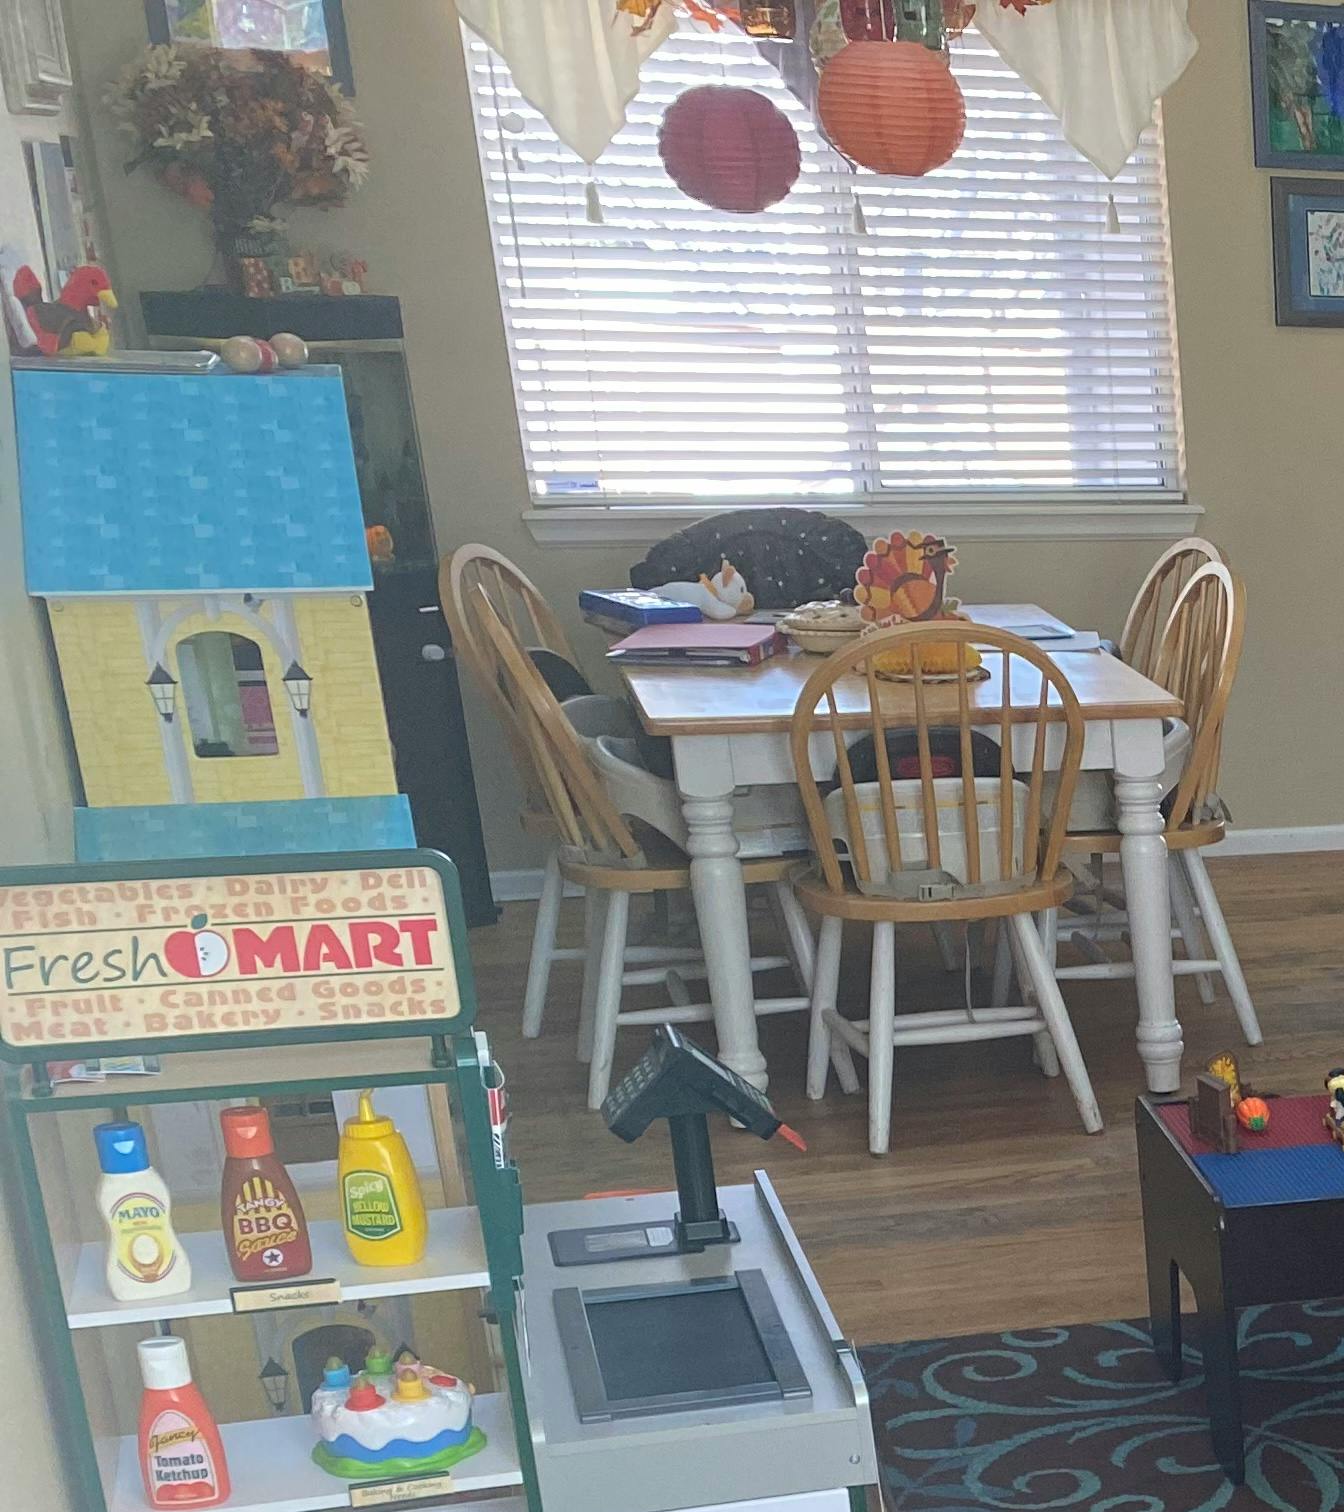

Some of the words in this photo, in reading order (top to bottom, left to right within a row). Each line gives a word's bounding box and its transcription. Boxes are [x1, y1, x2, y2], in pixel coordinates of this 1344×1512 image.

[225, 875, 329, 897] Dairy
[359, 869, 427, 891] Deli
[12, 907, 97, 929] Fish
[136, 900, 274, 923] Frozen
[291, 892, 409, 916] Foods
[4, 935, 168, 990] Fresh
[232, 918, 438, 975] MART
[25, 993, 124, 1017] Fruit
[160, 982, 297, 1009] Canned
[311, 975, 427, 999] Goods
[11, 1017, 109, 1042] Meat
[143, 1008, 281, 1033] Bakery
[318, 997, 447, 1021] Snacks
[350, 1179, 384, 1199] Spicy
[118, 1206, 160, 1223] MAYO
[236, 1198, 284, 1213] TANGY
[238, 1213, 294, 1235] BBQ
[351, 1214, 396, 1226] MUSTARD
[237, 1229, 298, 1260] Sauce
[153, 1453, 204, 1467] Tomato
[155, 1468, 209, 1481] Ketchup
